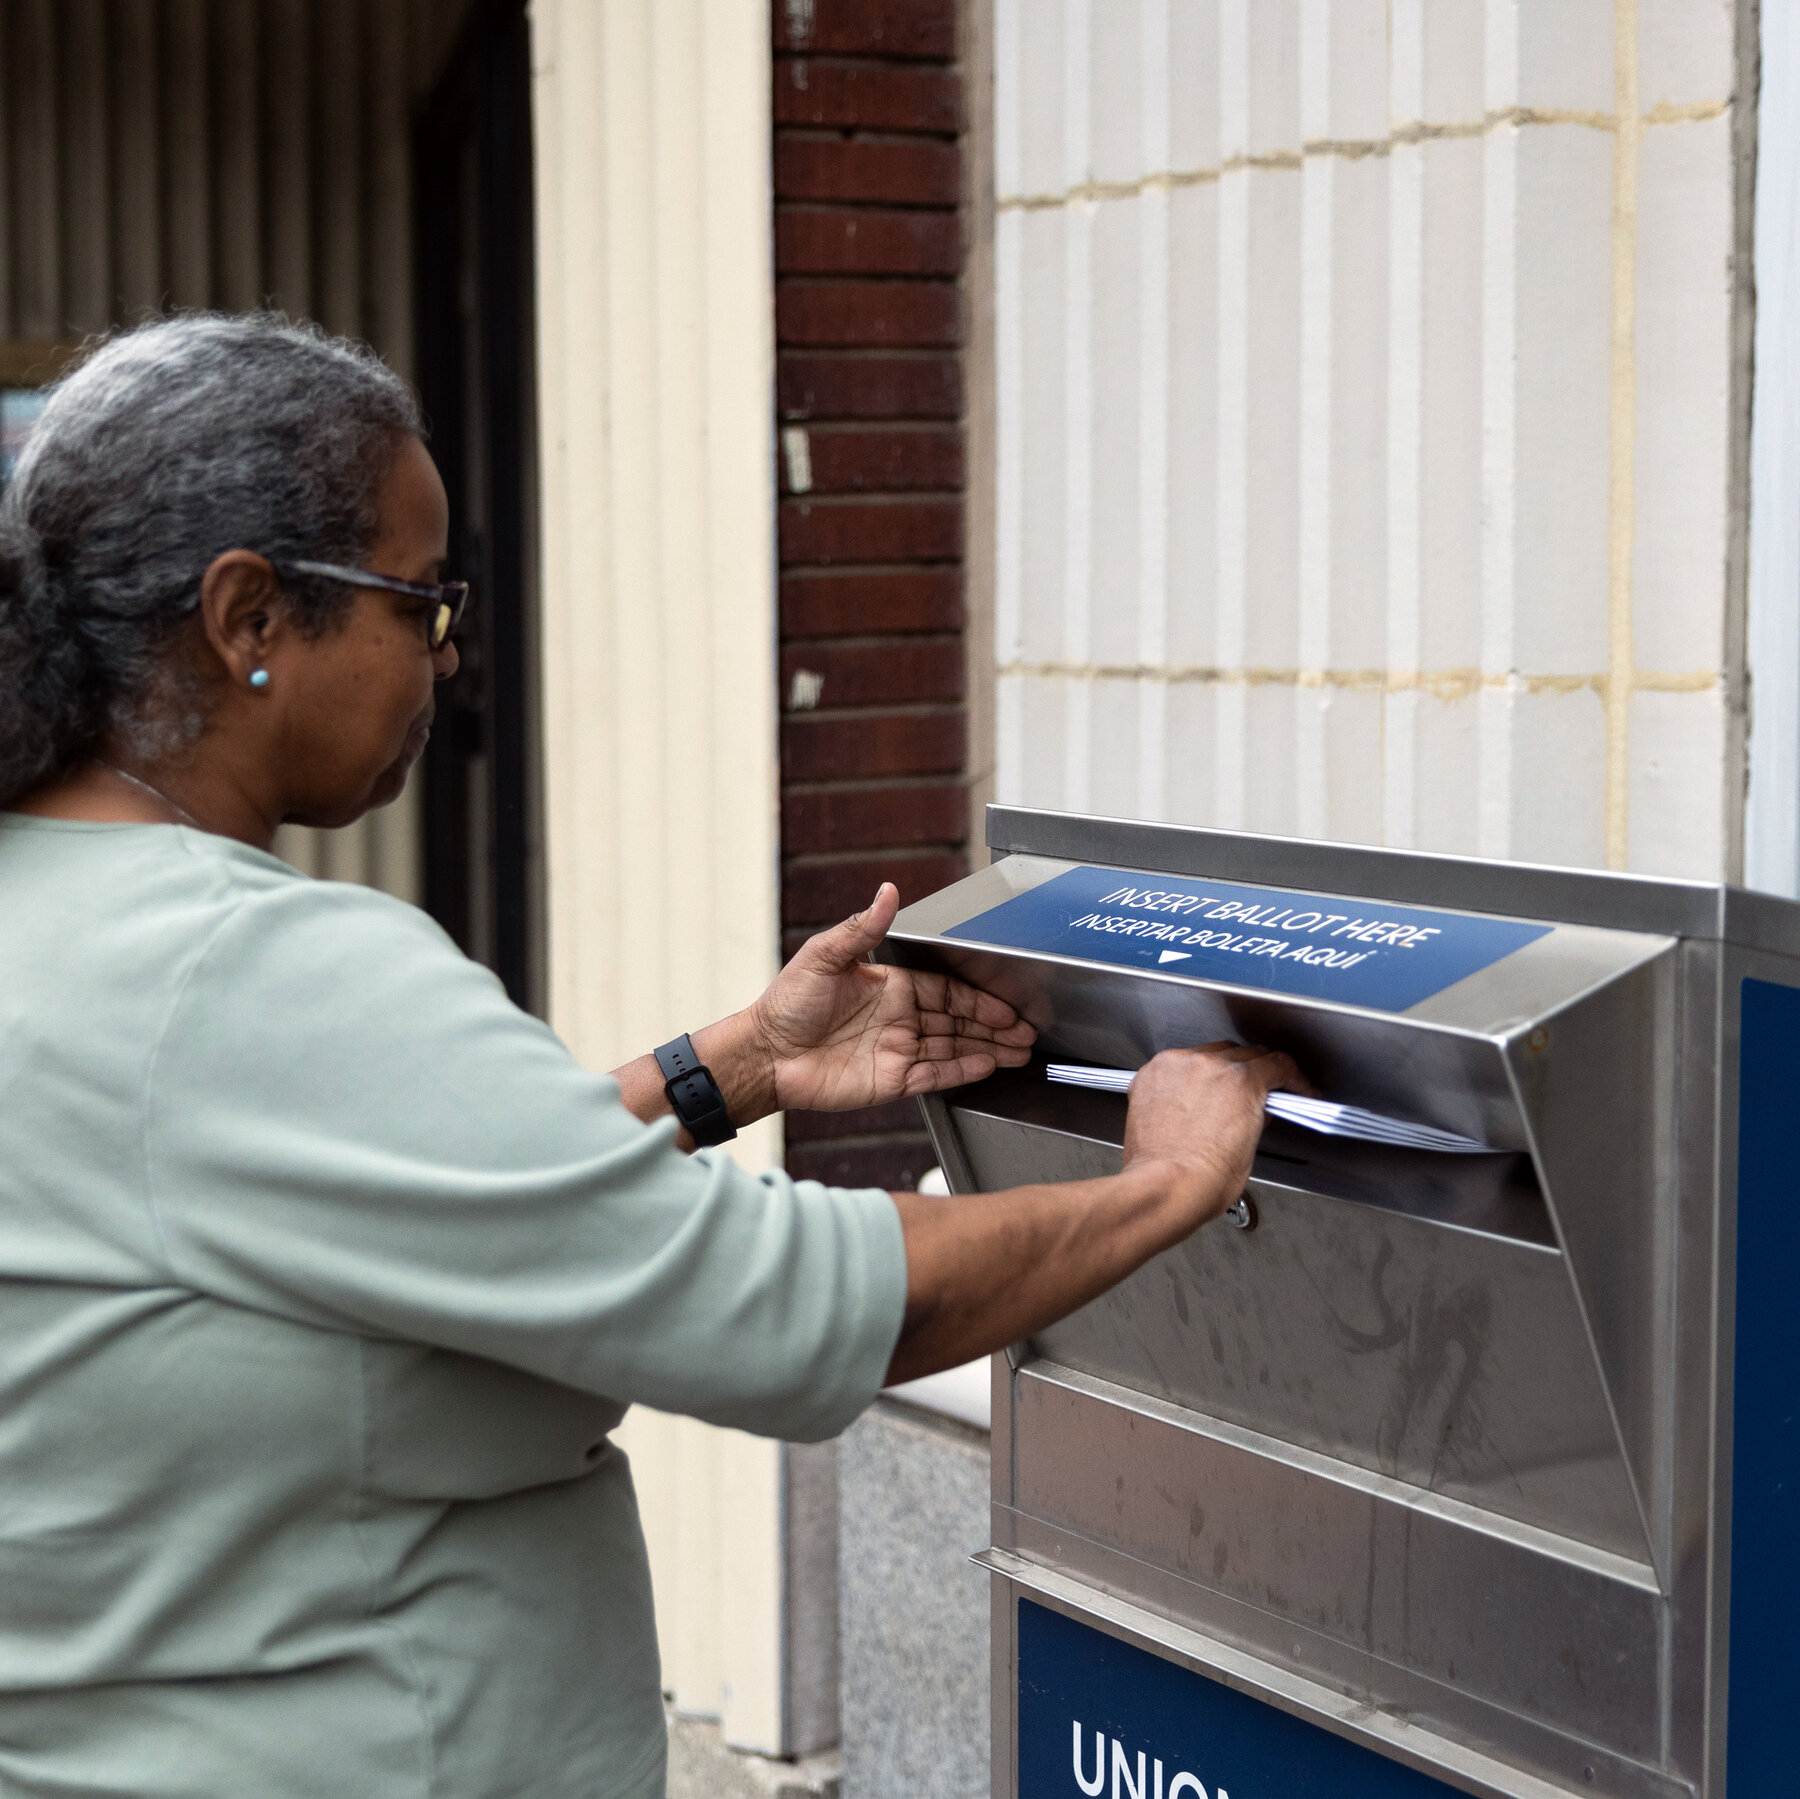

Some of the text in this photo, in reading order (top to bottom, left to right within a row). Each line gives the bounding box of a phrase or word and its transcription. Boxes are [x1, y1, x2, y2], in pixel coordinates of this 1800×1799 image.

[1069, 913, 1378, 969] INSERTAR BOLETA AQUÍ
[1099, 887, 1441, 948] INSERT BALLOT HERE
[1073, 1720, 1230, 1799] UNI
